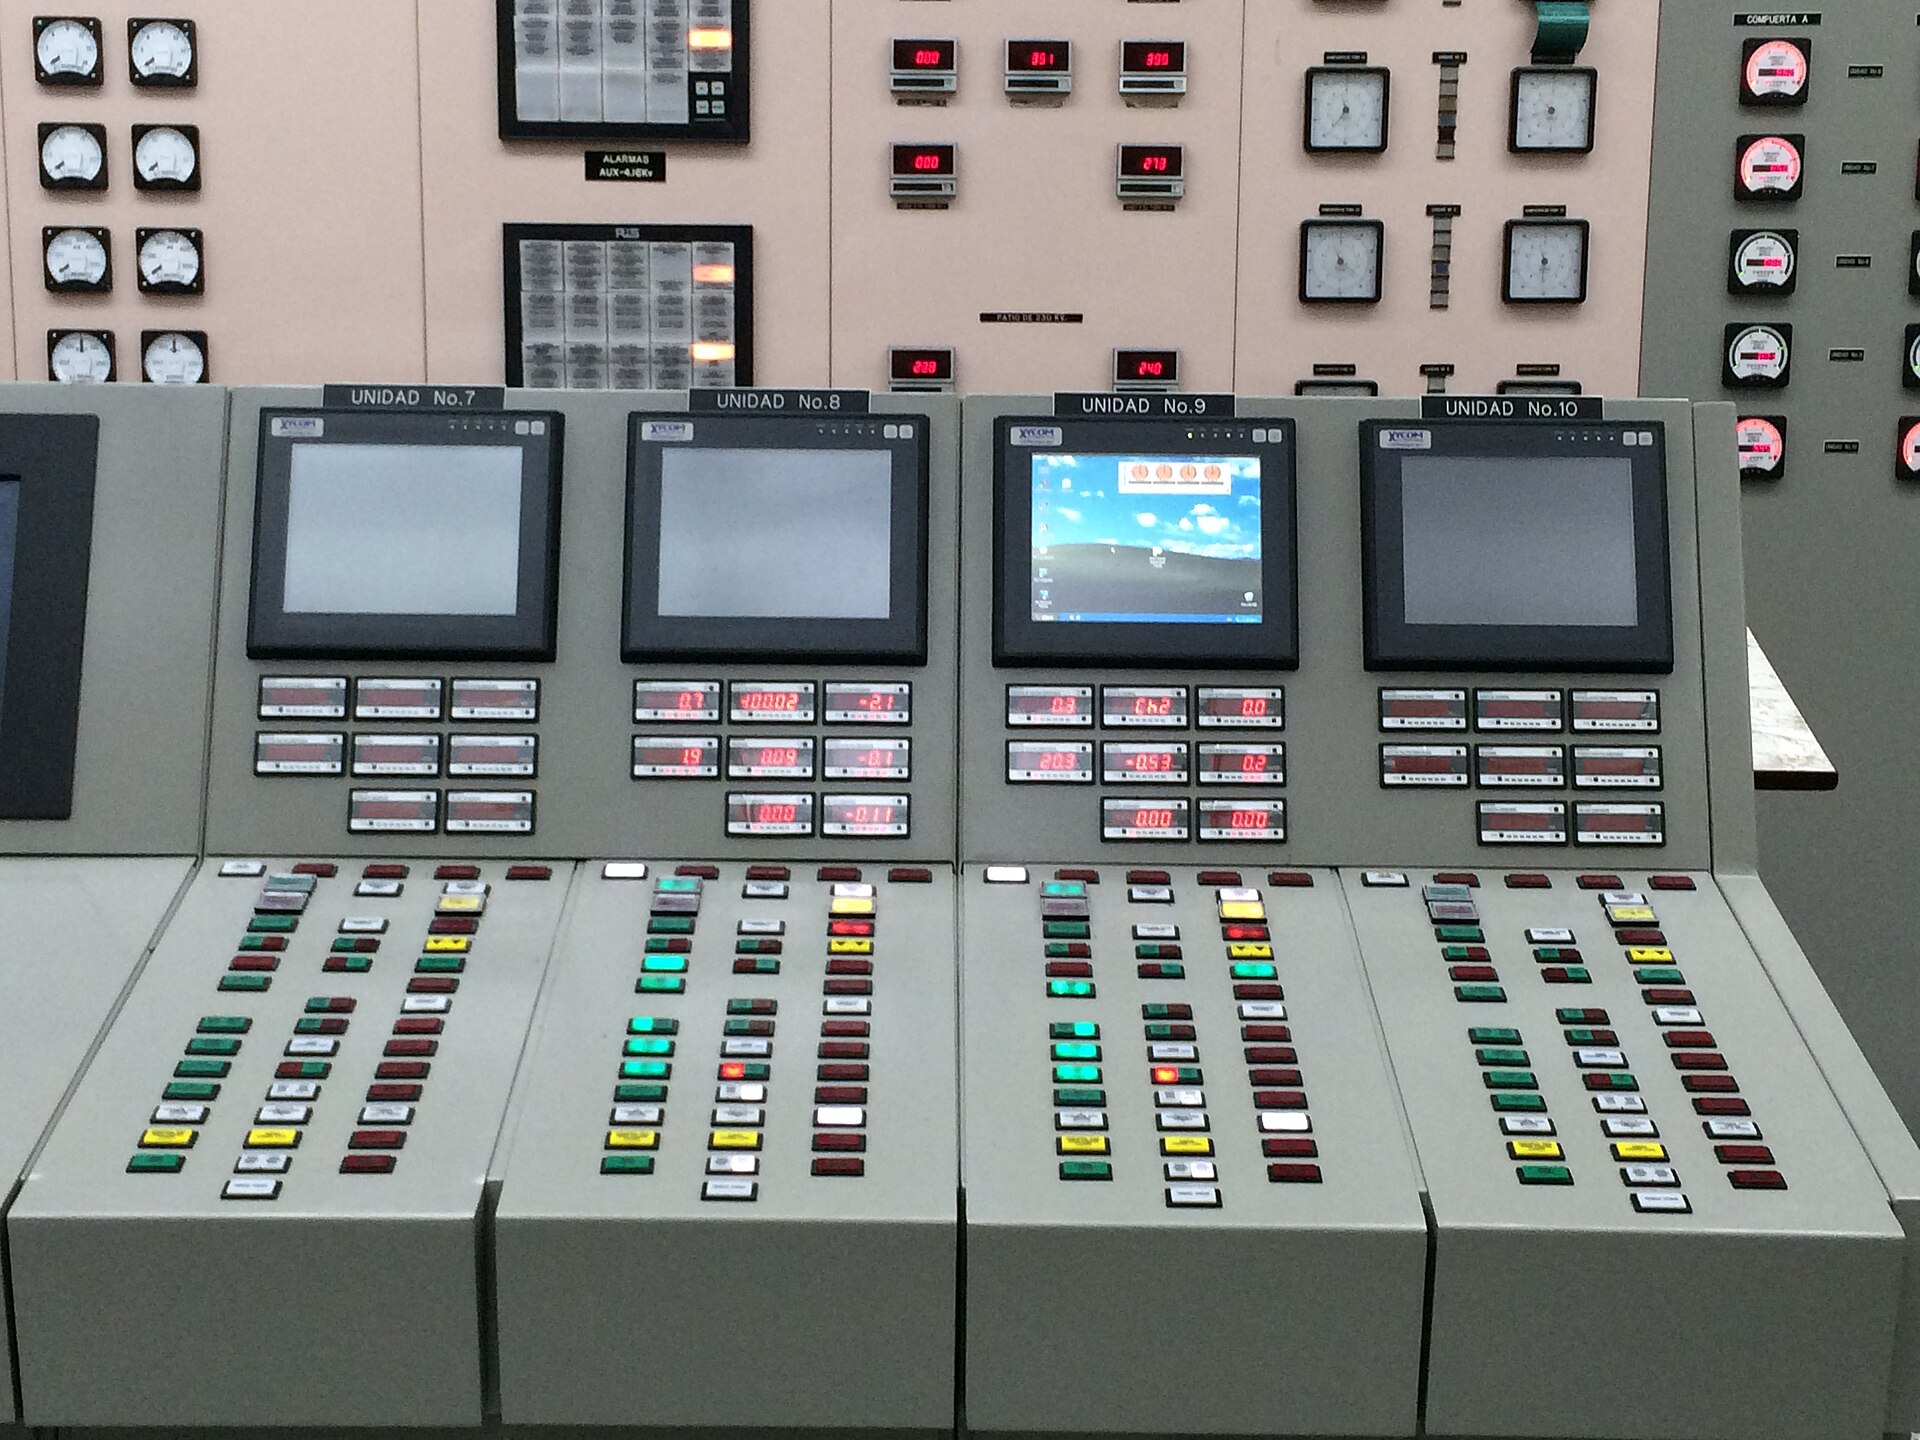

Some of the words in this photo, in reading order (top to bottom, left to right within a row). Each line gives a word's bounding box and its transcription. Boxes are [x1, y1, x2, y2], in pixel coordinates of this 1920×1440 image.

[1747, 14, 1796, 25] COMPUERTA
[1801, 15, 1809, 24] A
[603, 155, 650, 165] ALARMAS
[997, 314, 1021, 322] PATIO
[1022, 314, 1033, 322] DE
[352, 390, 420, 406] UNIDAD
[434, 390, 476, 407] No.7
[717, 394, 785, 410] UNIDAD
[798, 394, 841, 411] No.8
[1083, 397, 1151, 414] UNIDAD
[1164, 398, 1206, 415] No.9
[1446, 400, 1514, 417] UNIDAD
[1529, 401, 1578, 418] No.10
